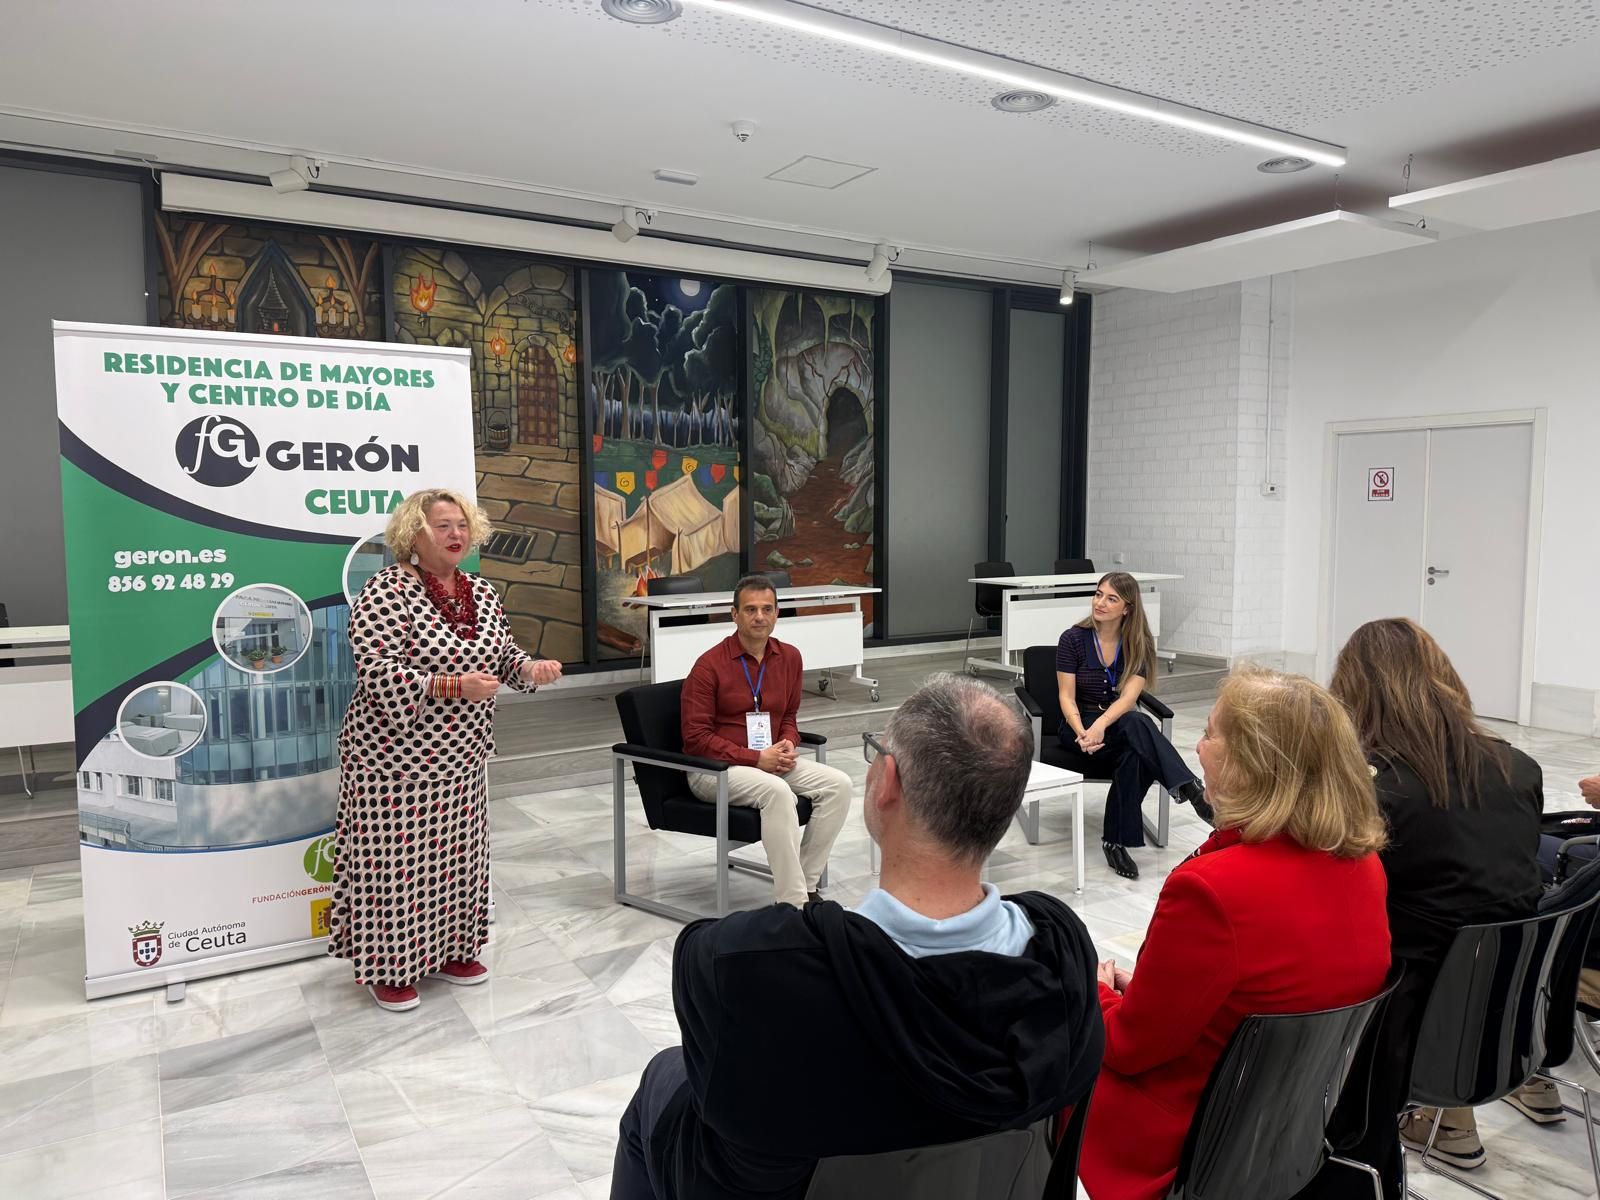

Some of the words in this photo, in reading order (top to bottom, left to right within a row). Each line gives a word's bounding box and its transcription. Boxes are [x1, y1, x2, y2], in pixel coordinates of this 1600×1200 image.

[103, 351, 273, 380] RESIDENCIA
[280, 361, 313, 382] DE
[320, 364, 435, 389] MAYORES
[160, 382, 180, 403] Y
[188, 383, 299, 408] CENTRO
[307, 388, 339, 409] DE
[346, 387, 391, 411] DÍA
[265, 436, 420, 473] GERÓN
[114, 549, 227, 569] geron.es
[108, 575, 147, 592] 856
[151, 574, 176, 590] 92
[180, 573, 206, 590] 48
[210, 572, 235, 588] 29
[167, 928, 199, 940] Ciudad
[201, 921, 246, 934] Autónoma
[168, 940, 181, 949] de
[186, 931, 247, 952] Ceuta
